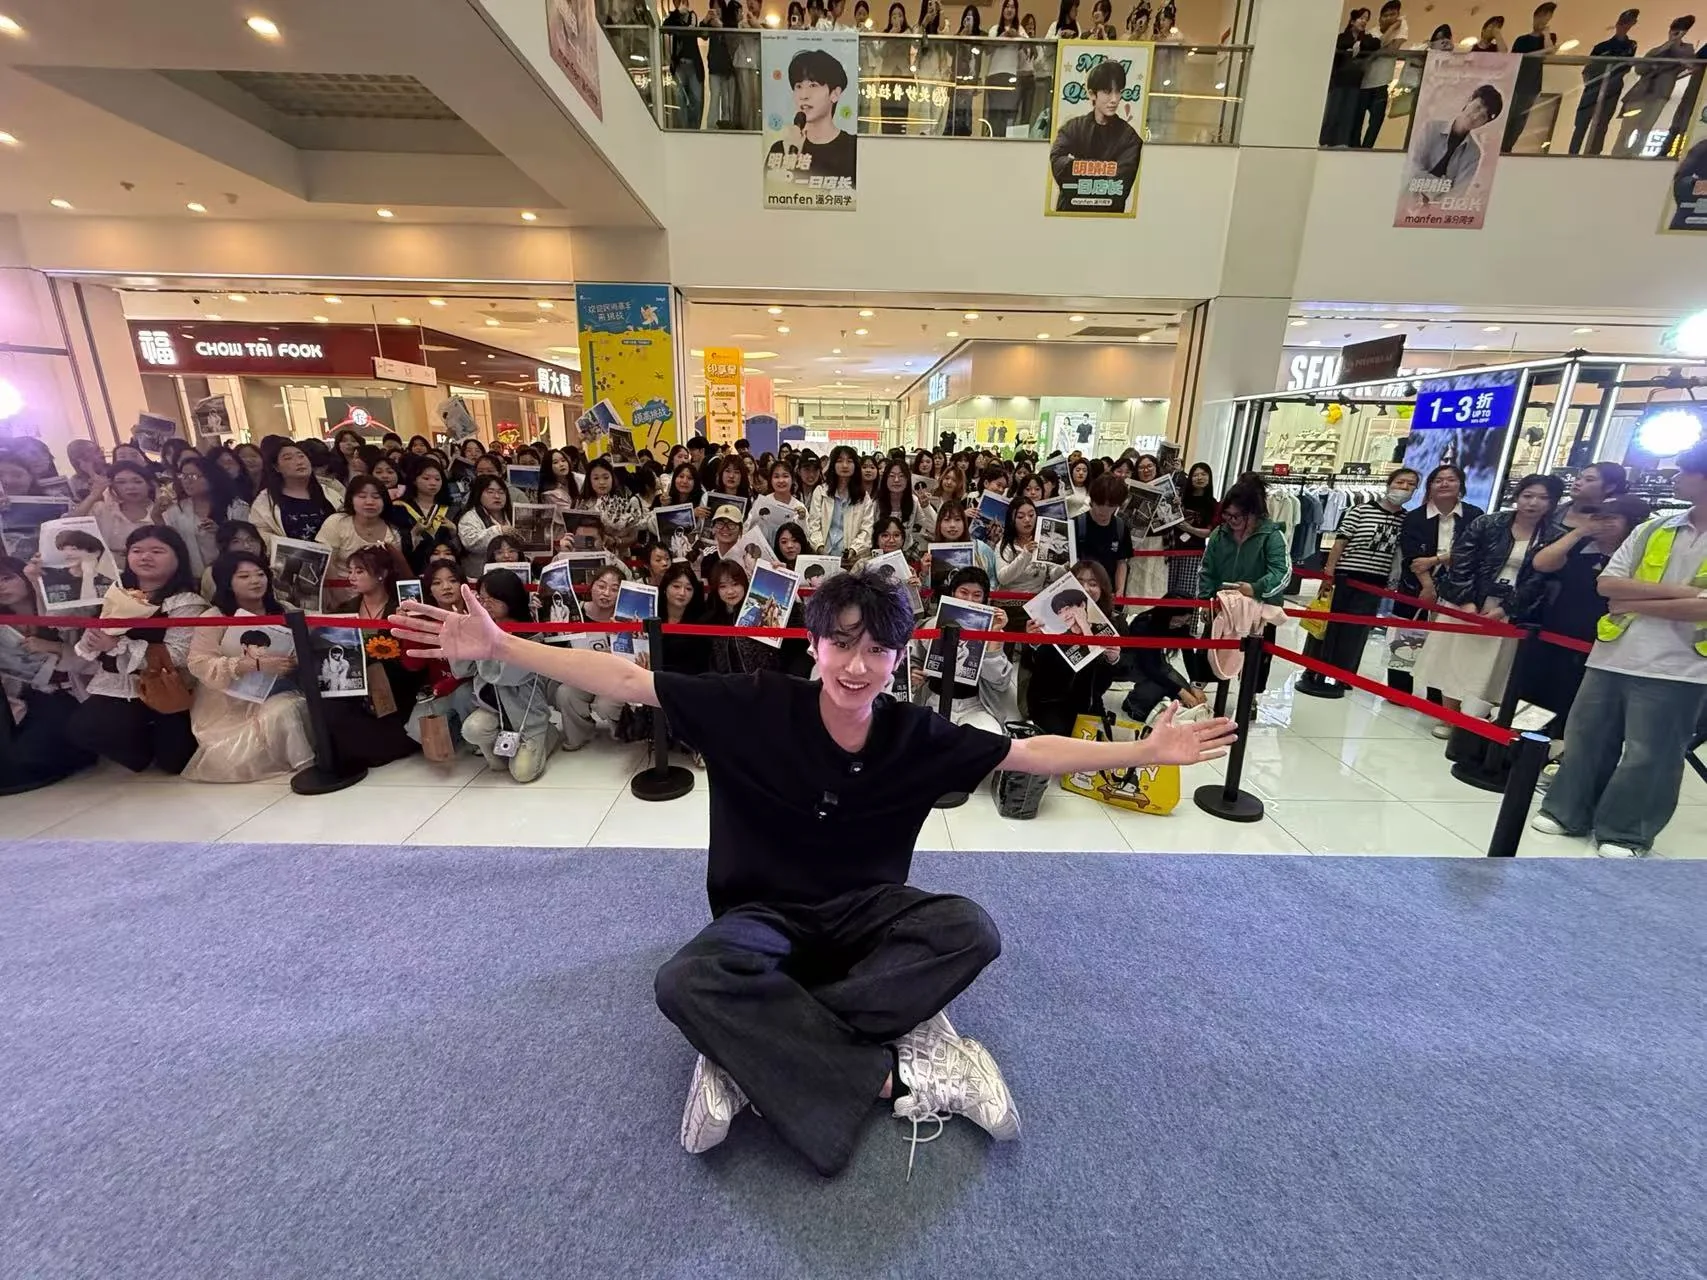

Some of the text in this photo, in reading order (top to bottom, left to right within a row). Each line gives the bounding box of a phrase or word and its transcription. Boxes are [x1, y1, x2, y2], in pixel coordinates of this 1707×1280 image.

[795, 175, 853, 189] 一日店长
[1062, 179, 1124, 195] 一日店长
[768, 194, 813, 204] manfen
[1405, 214, 1442, 224] manfen
[138, 330, 177, 365] 福
[195, 342, 323, 358] CHOW TAI FOOK
[537, 368, 572, 397] 周大福
